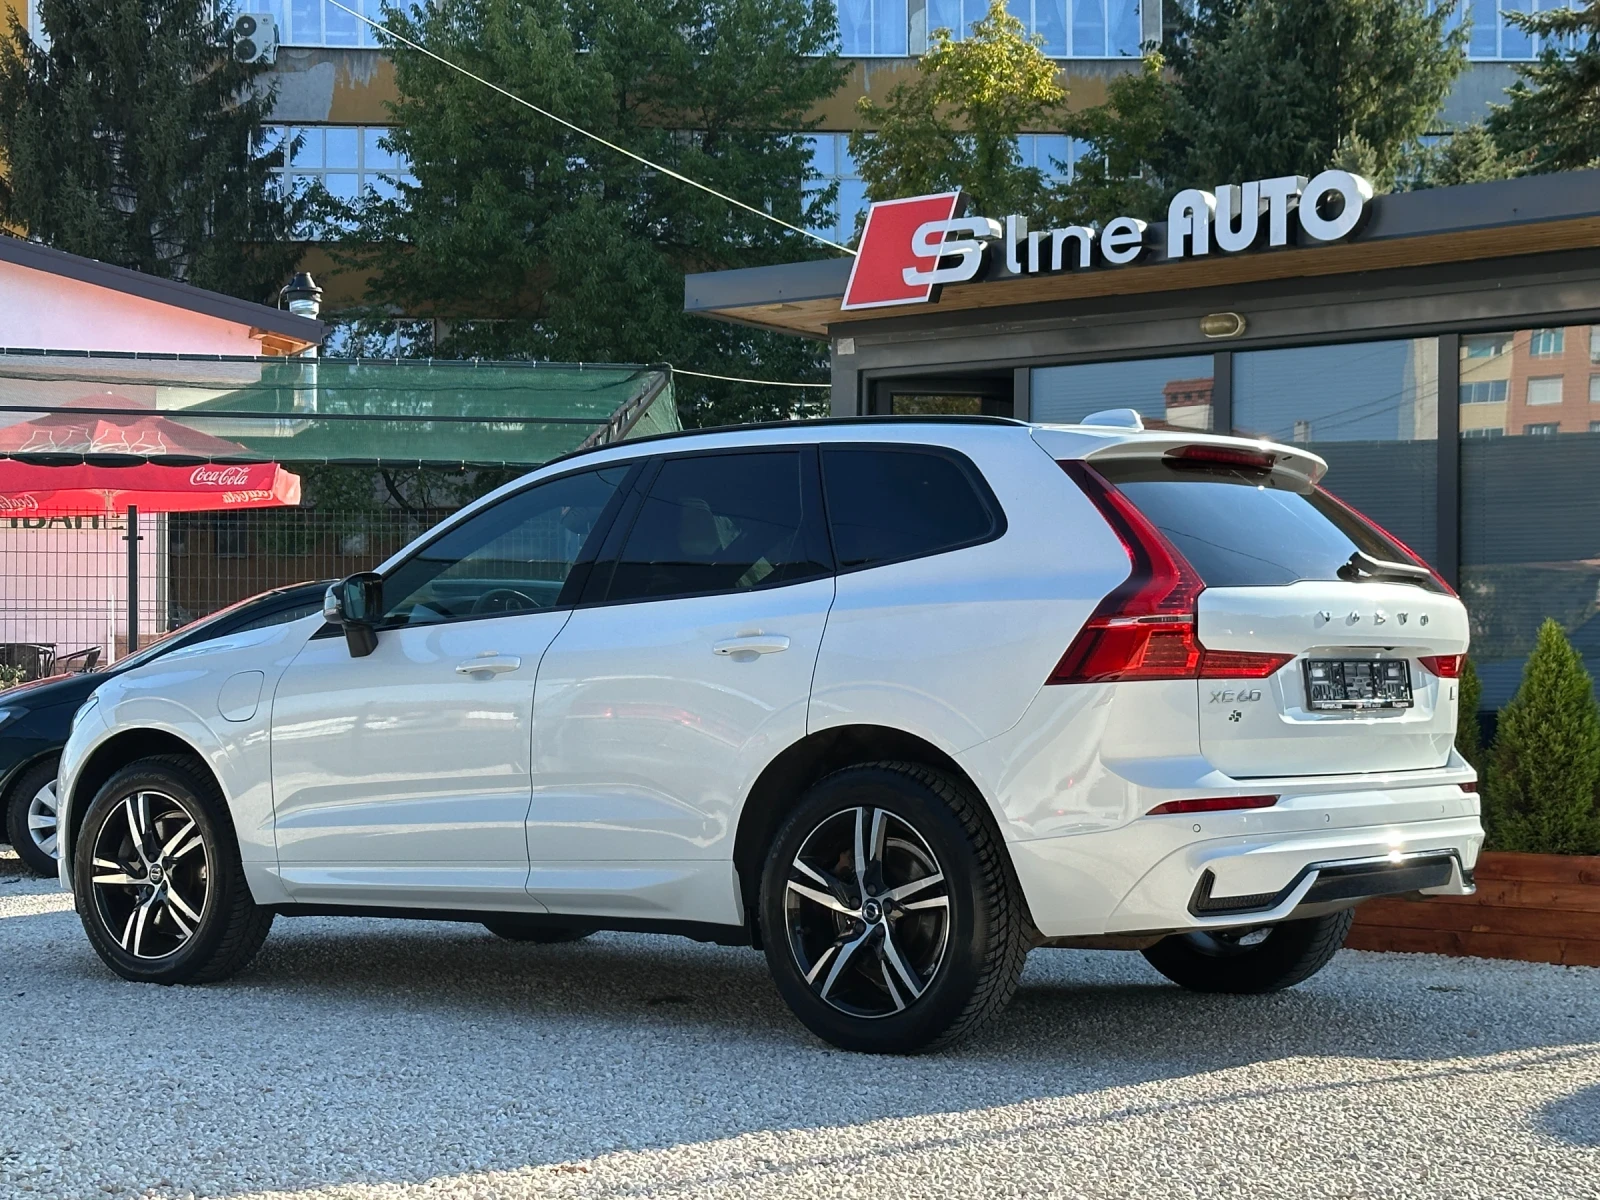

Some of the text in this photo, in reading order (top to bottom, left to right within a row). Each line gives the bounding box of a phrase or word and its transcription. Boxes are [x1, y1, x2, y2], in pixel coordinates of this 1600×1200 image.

[902, 169, 1371, 287] S line AUTO
[189, 466, 252, 486] Coca-Cola
[1208, 688, 1262, 704] XC60
